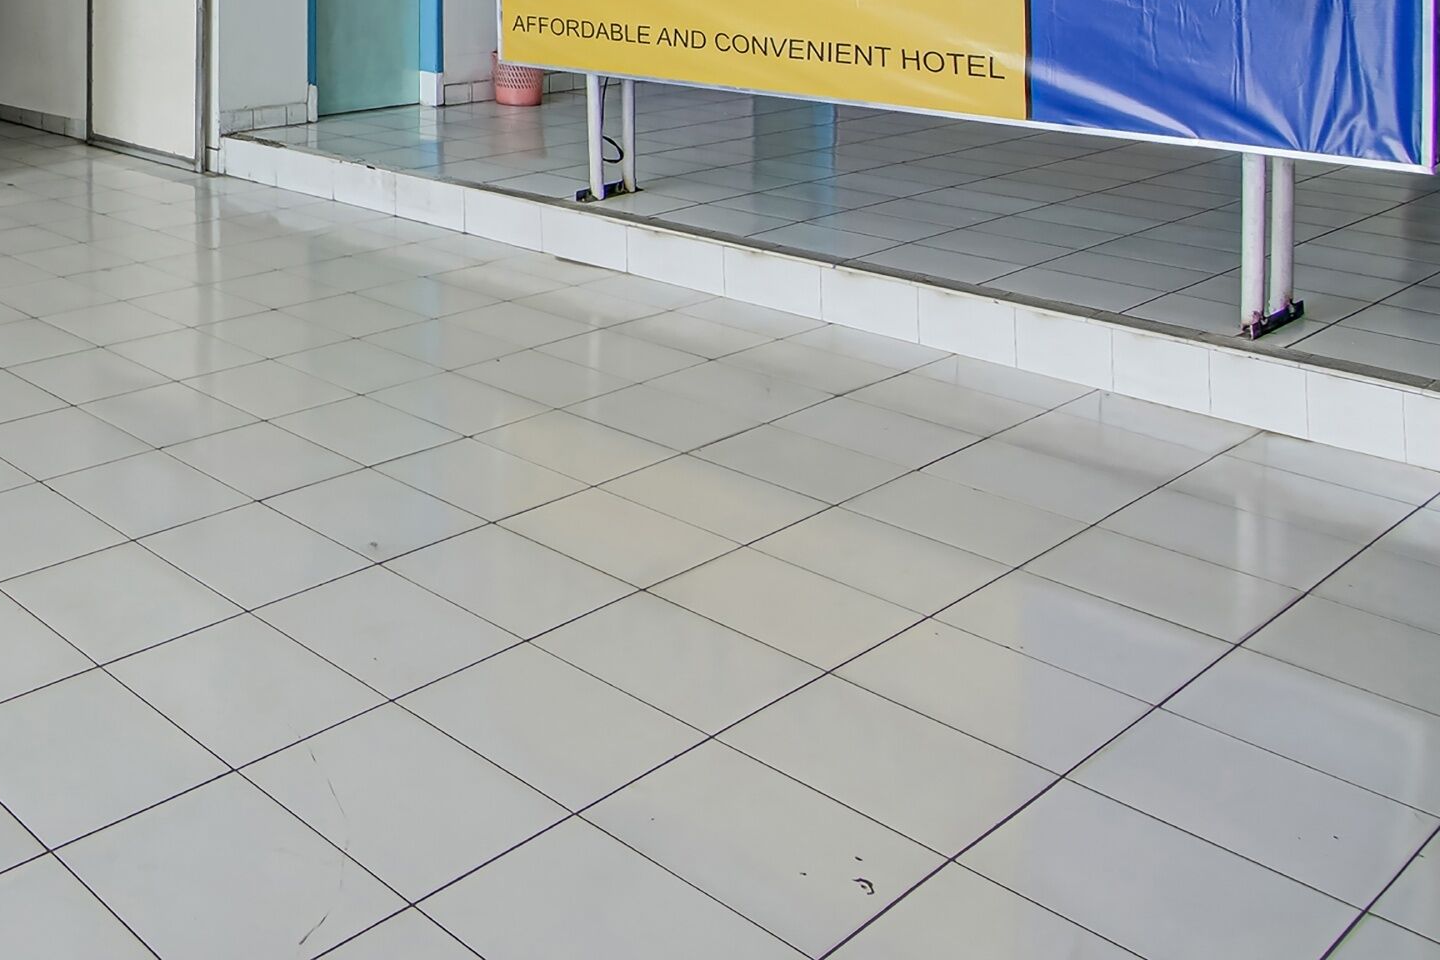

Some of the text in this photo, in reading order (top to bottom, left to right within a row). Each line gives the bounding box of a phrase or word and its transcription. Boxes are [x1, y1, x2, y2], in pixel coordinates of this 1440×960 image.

[511, 14, 1006, 82] AFFORDABLE AND CONVENIENT HOTEL
